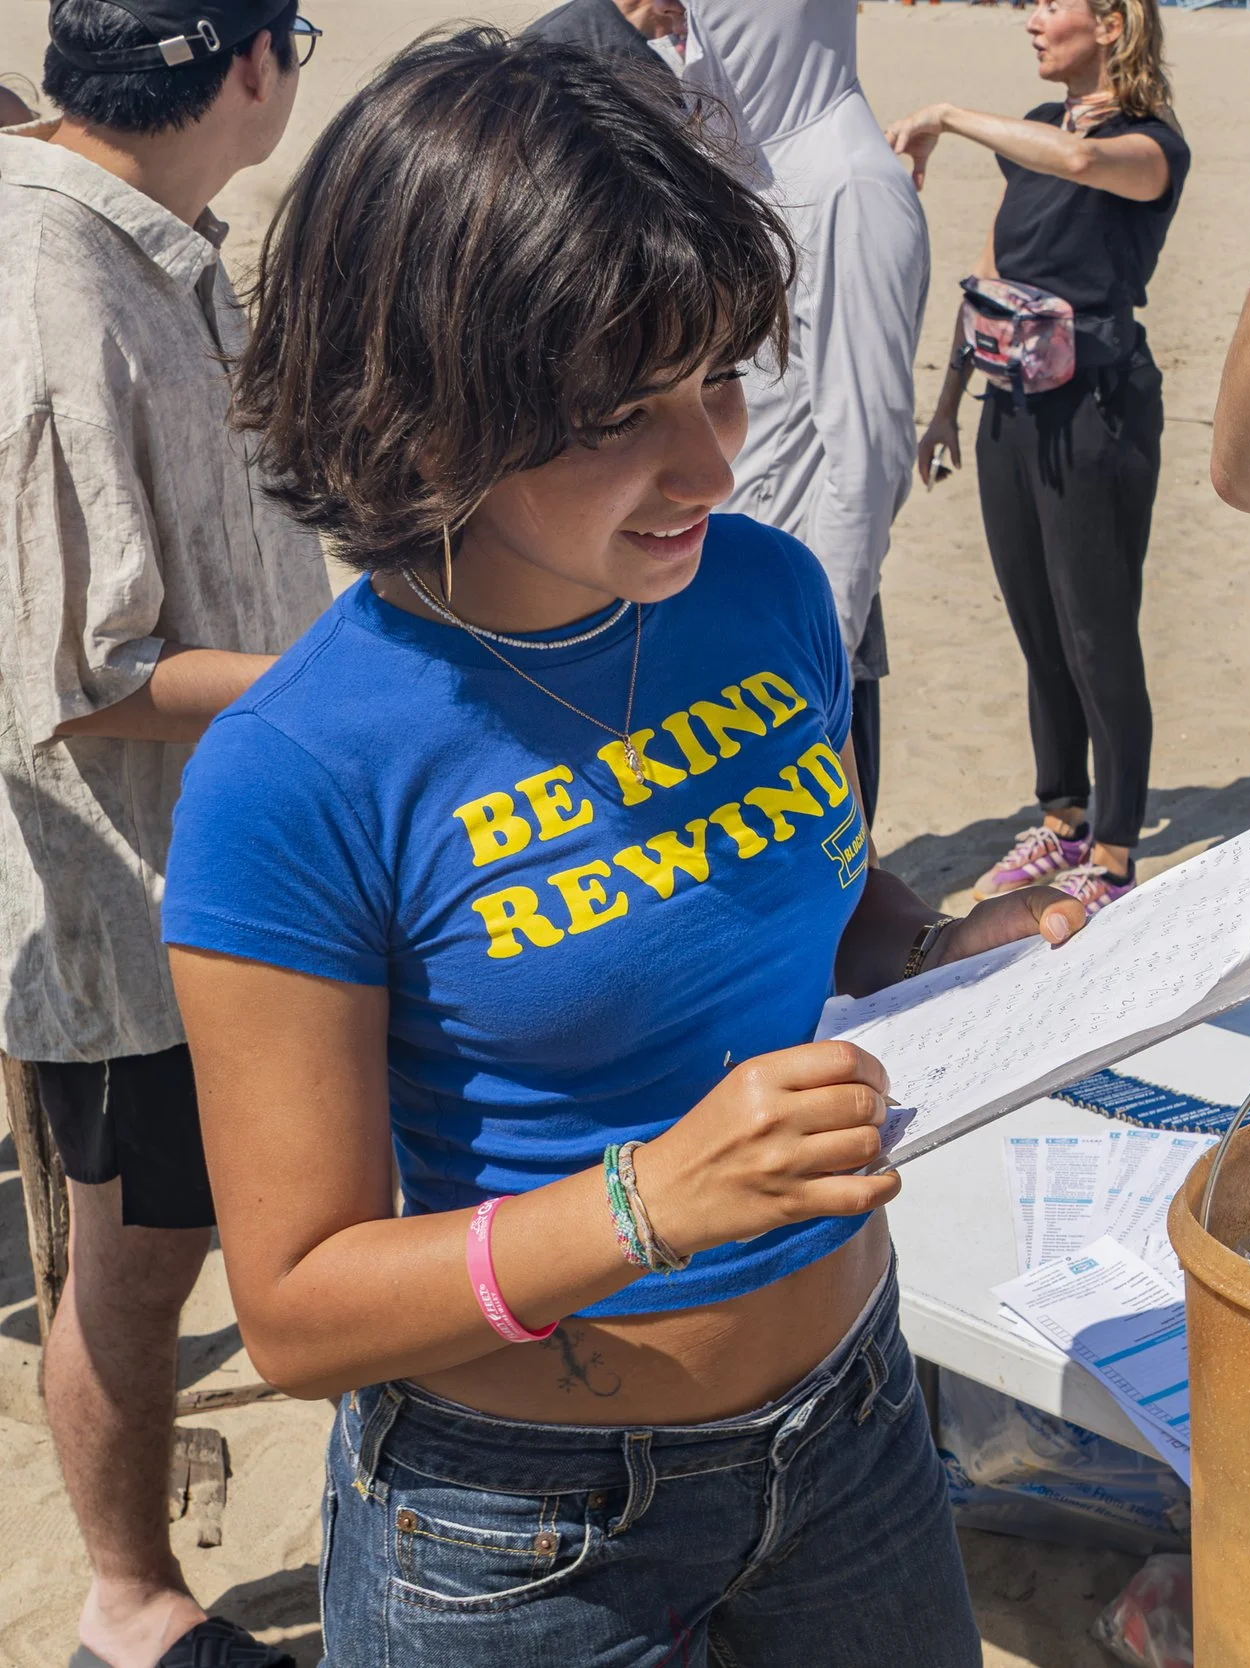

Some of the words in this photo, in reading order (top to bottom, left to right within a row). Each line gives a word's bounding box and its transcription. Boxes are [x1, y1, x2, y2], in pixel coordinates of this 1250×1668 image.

[452, 764, 594, 868] BE
[597, 671, 807, 807] KIND
[471, 742, 850, 959] REWIND
